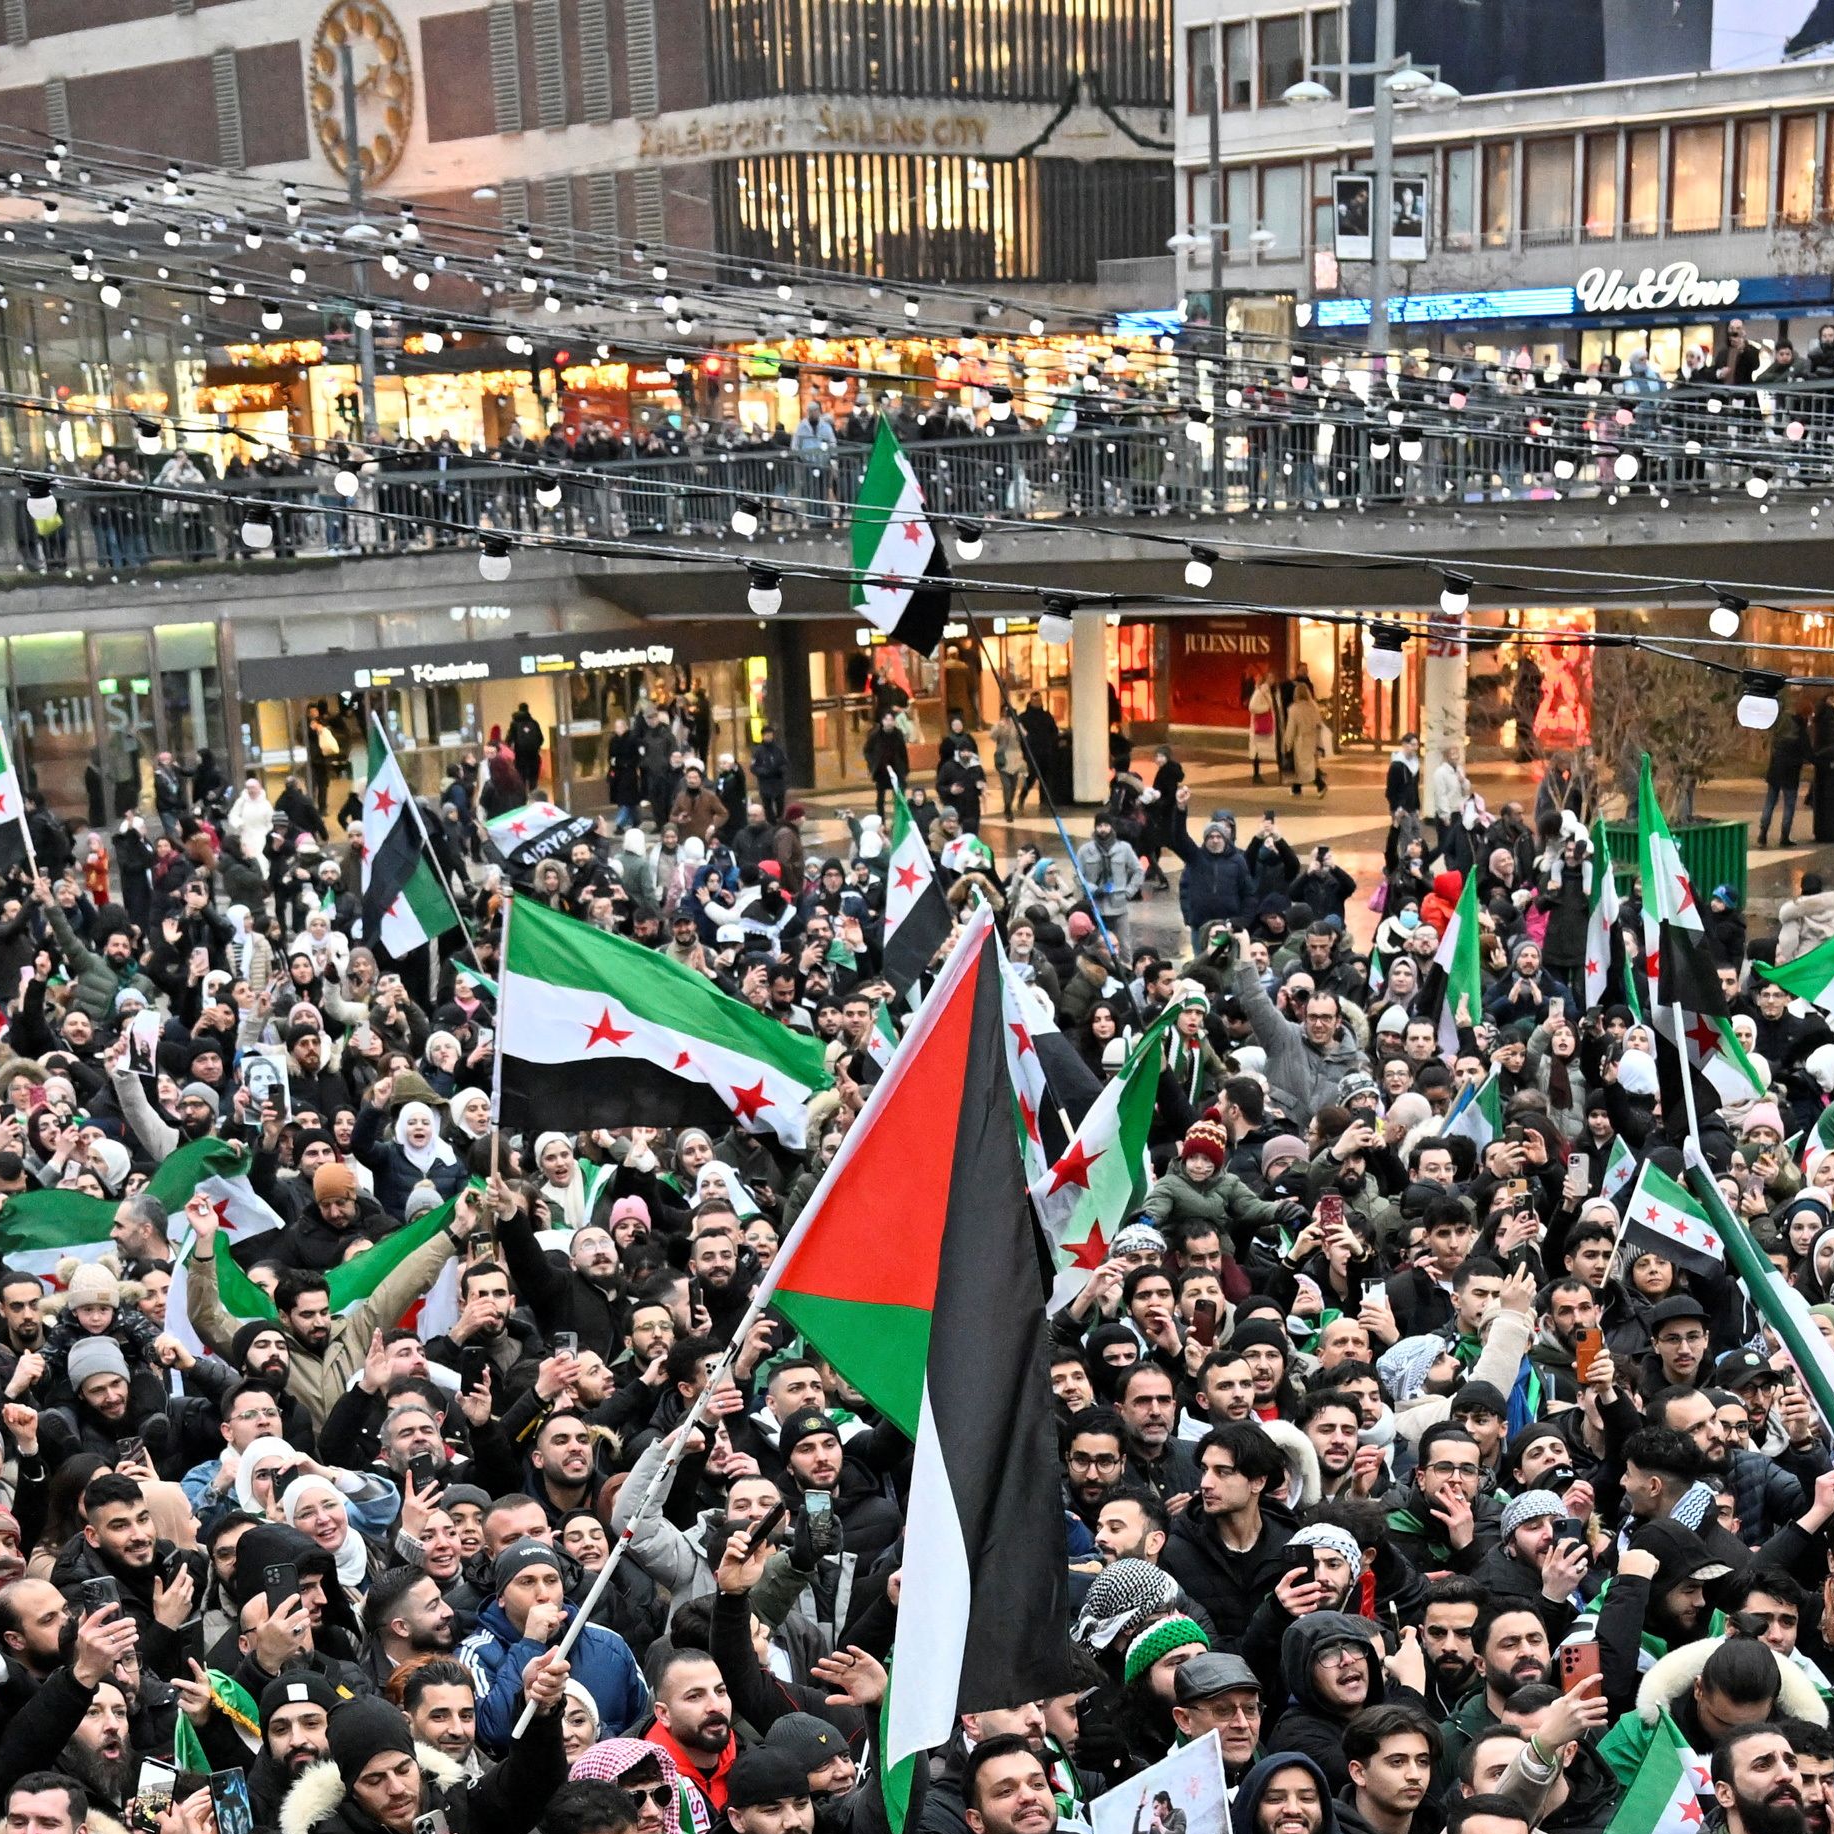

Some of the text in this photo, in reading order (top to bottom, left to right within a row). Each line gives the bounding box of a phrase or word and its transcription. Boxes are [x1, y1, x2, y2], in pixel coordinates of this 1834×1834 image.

[1576, 261, 1740, 313] Ur&Penn
[647, 645, 674, 665] City
[1185, 633, 1271, 655] JULENS HUS
[43, 696, 93, 738] till
[103, 695, 154, 734] SL
